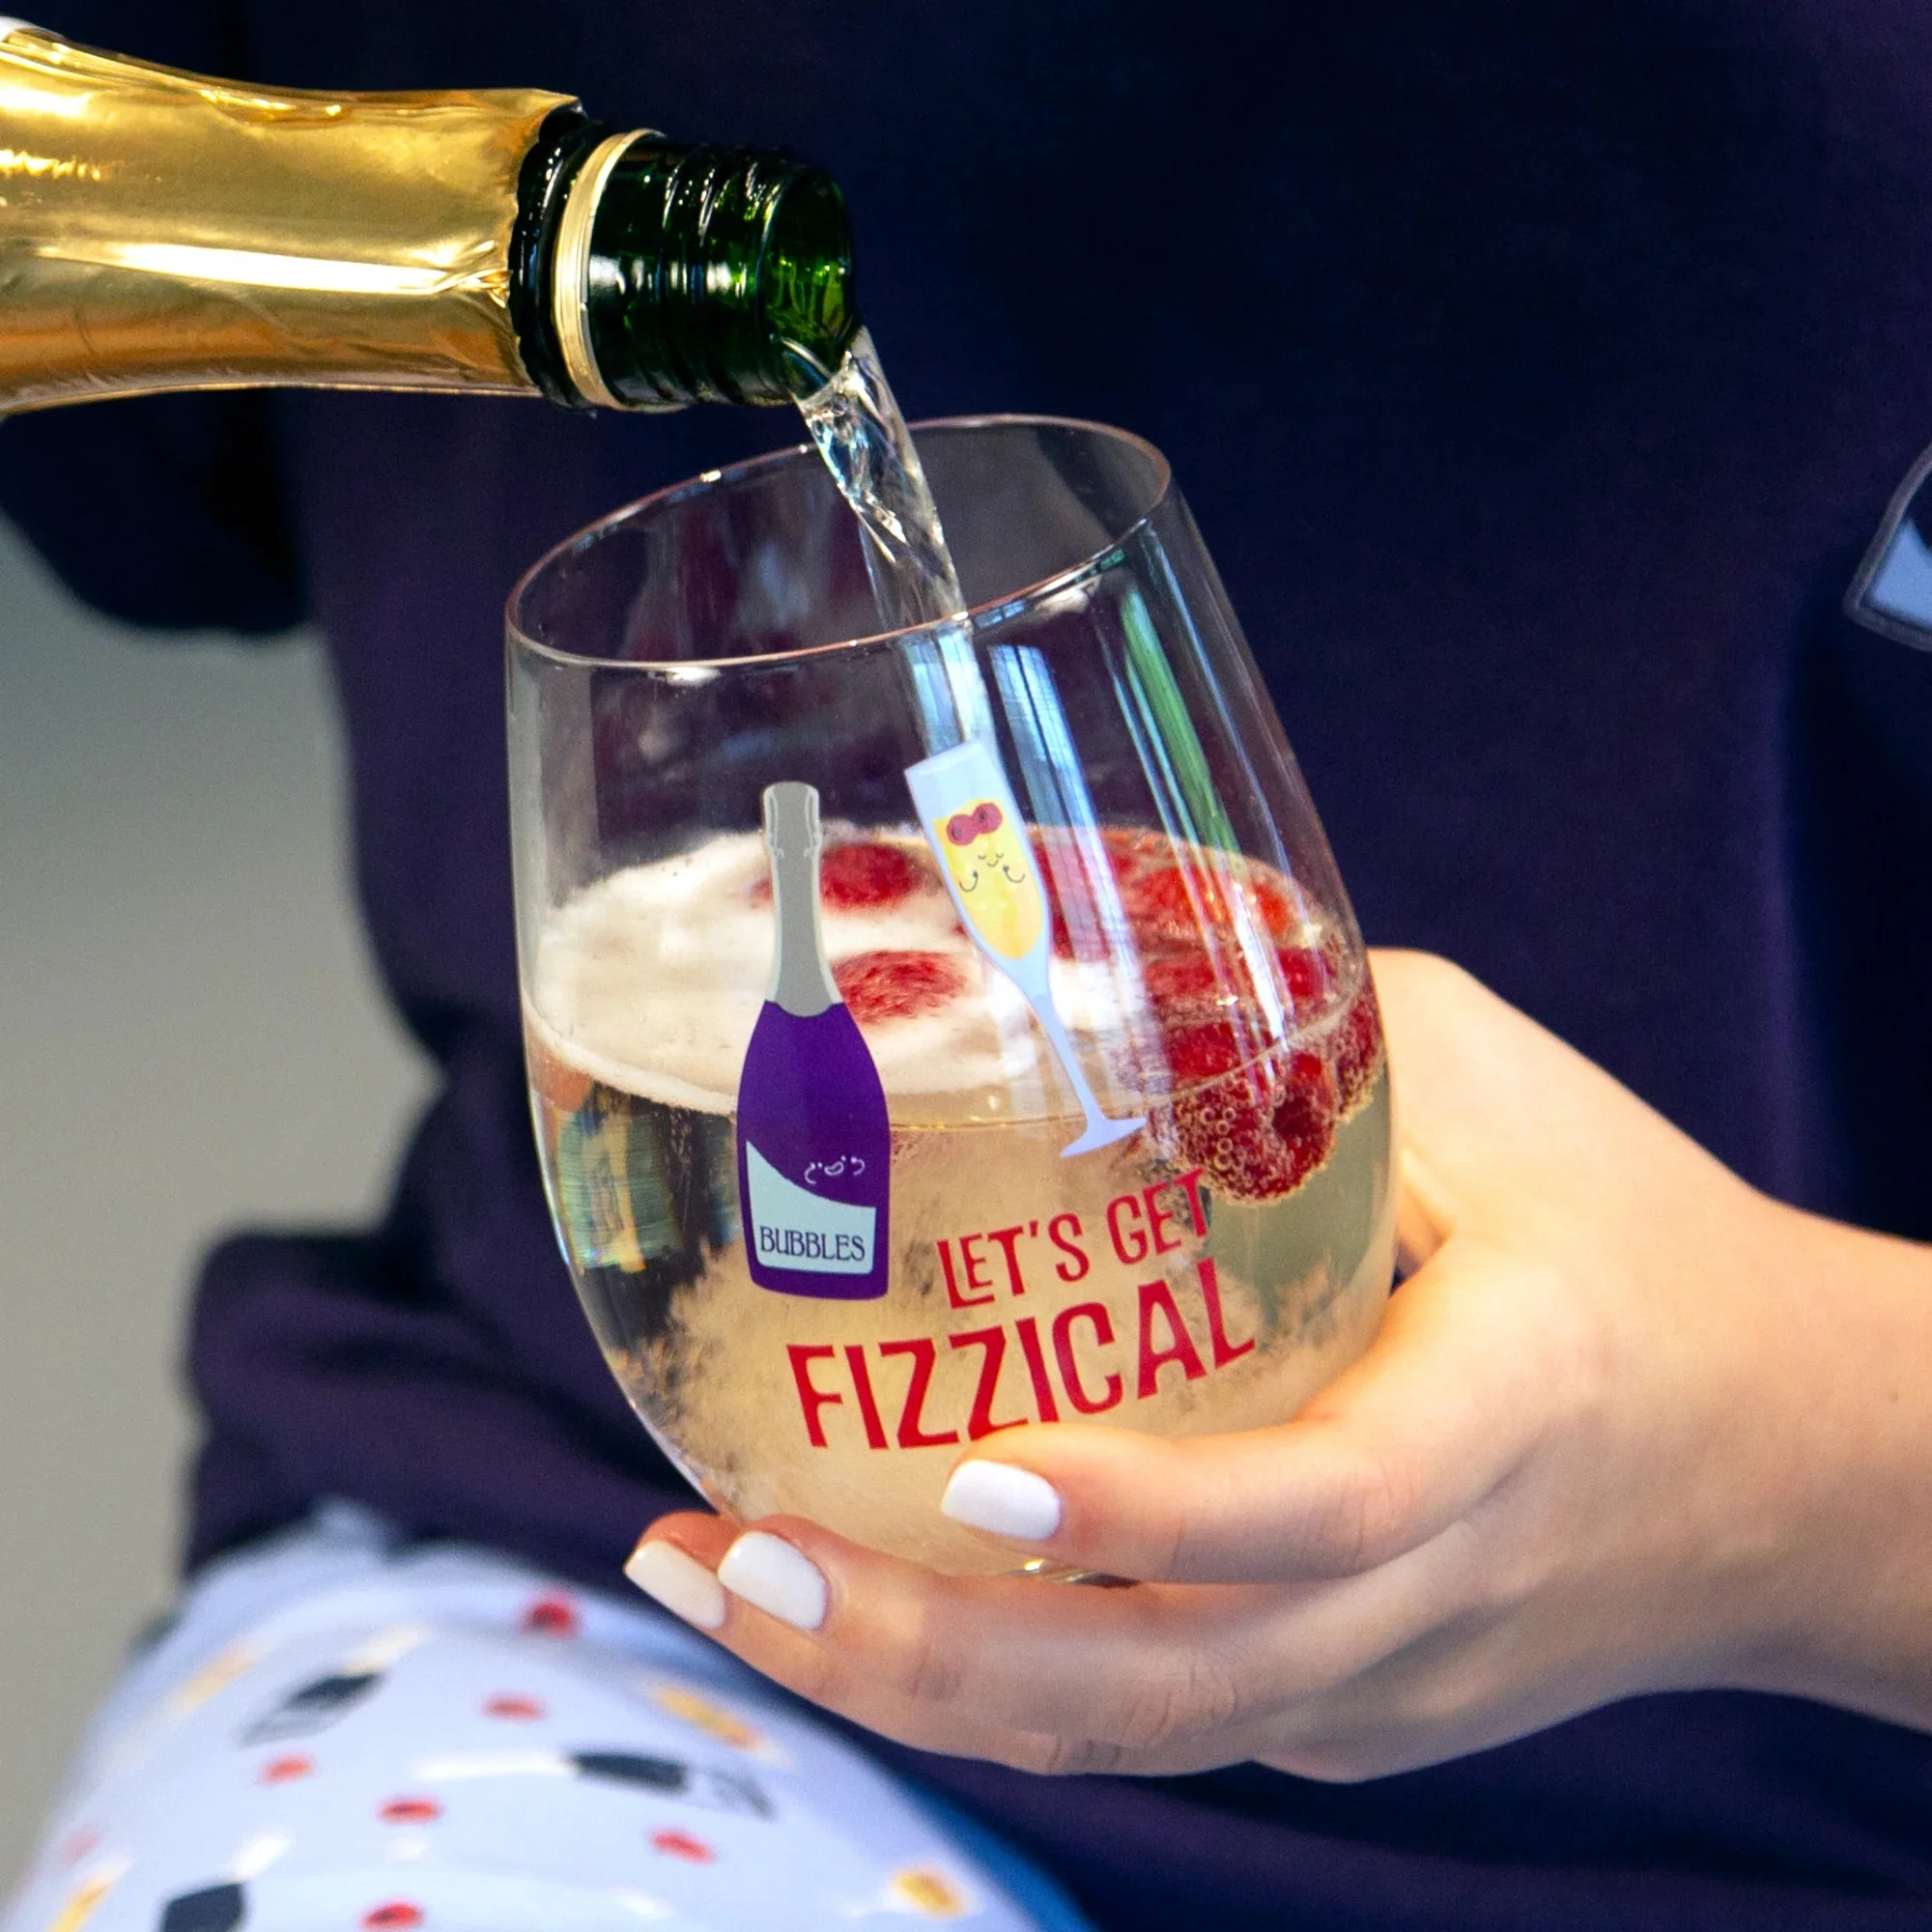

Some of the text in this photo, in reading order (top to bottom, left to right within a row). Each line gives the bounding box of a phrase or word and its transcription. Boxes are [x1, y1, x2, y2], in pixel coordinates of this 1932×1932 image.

[759, 1226, 866, 1262] BUBBLES
[937, 1169, 1208, 1309] LET'S GET
[787, 1260, 1255, 1449] FIZZICAL
